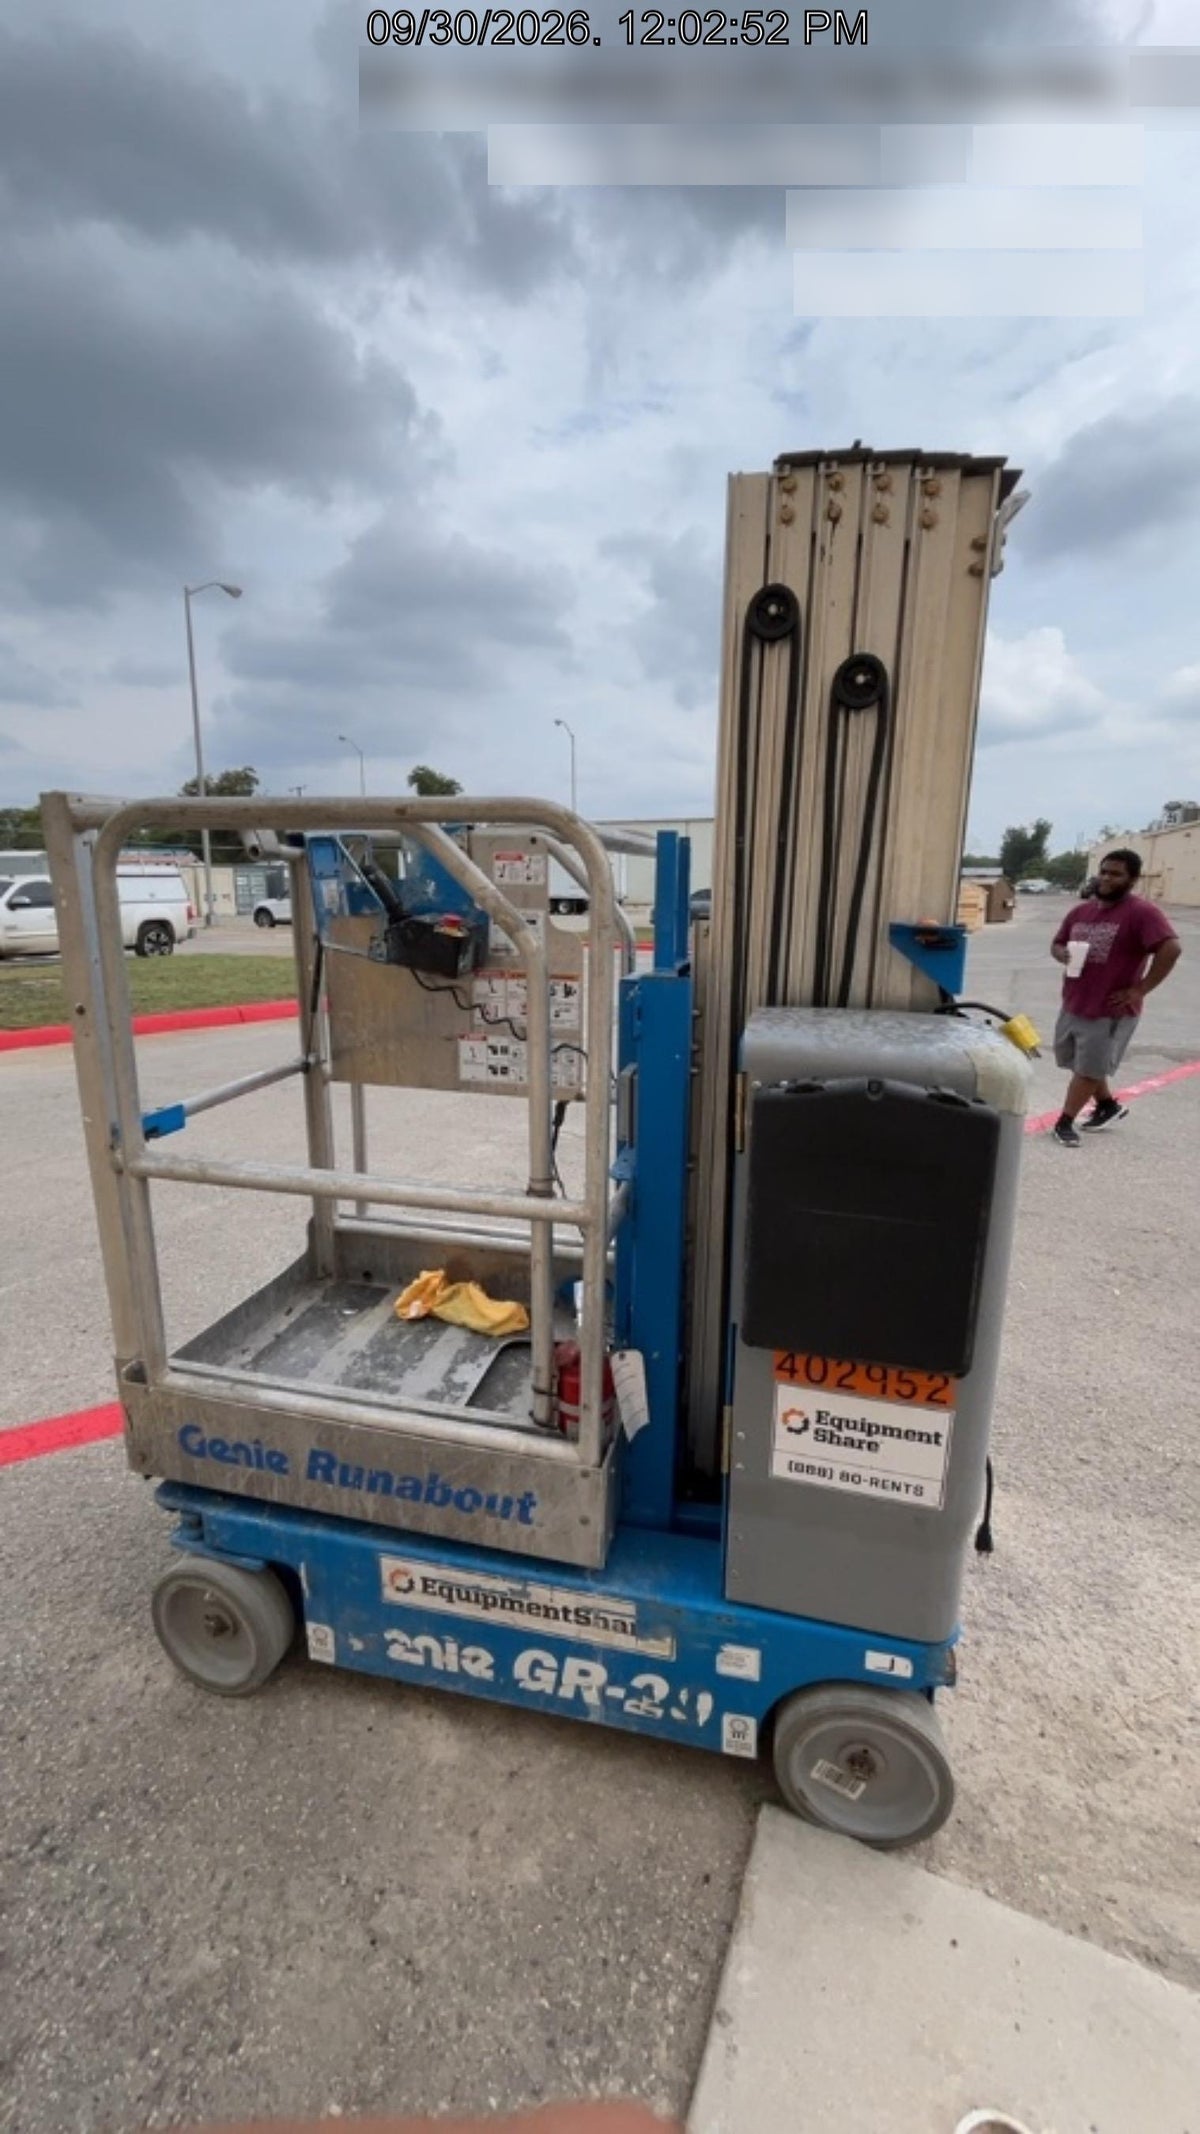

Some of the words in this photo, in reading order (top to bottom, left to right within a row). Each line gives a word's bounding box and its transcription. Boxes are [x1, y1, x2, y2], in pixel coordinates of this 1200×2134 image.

[775, 1352, 950, 1404] 402952
[813, 1426, 880, 1453] Share
[815, 1409, 943, 1447] Equipment
[177, 1424, 289, 1475] Genie
[306, 1447, 538, 1525] Runabout
[787, 1459, 834, 1480] (888)
[839, 1469, 924, 1498] 80-RENTS
